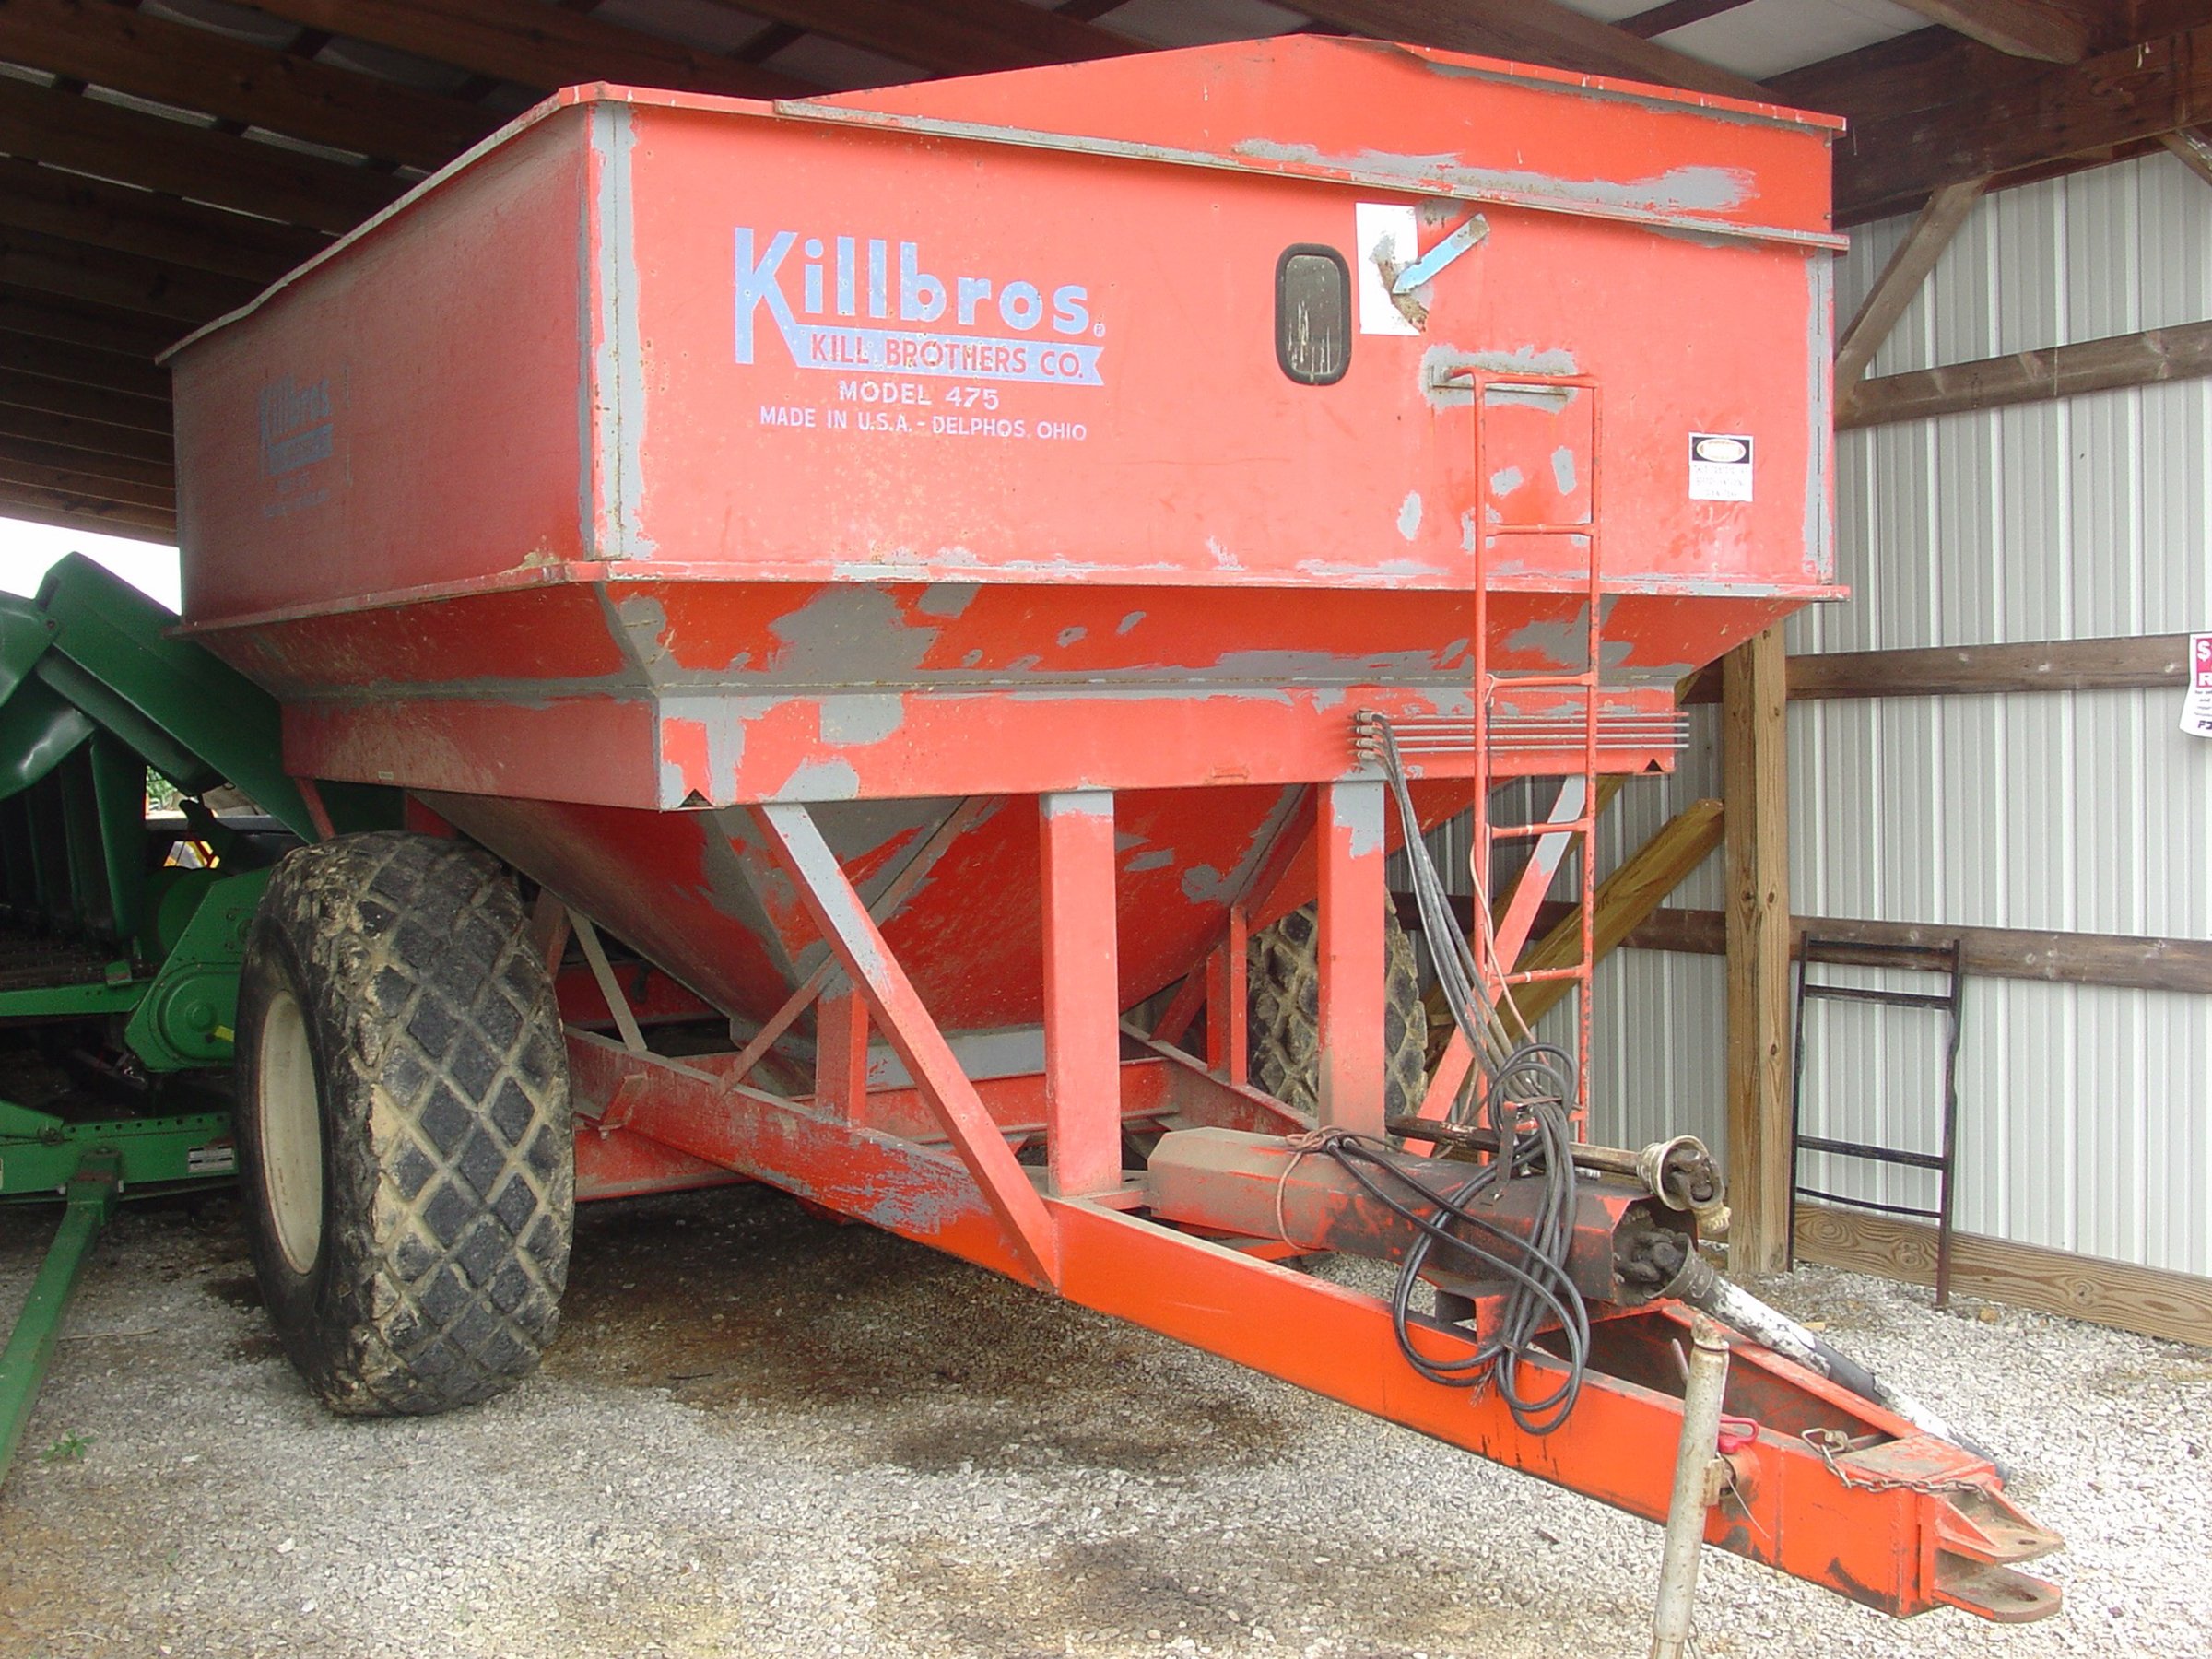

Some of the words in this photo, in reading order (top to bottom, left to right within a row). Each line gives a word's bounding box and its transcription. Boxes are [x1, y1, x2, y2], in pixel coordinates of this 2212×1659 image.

[735, 227, 1090, 365] Killbros
[810, 333, 870, 364] KILL
[885, 338, 1027, 374] BROTHERS
[1040, 350, 1084, 379] CO.
[839, 380, 933, 406] MODEL
[945, 386, 1000, 411] 475
[759, 406, 817, 428] MADE
[827, 409, 847, 429] IN
[1037, 421, 1087, 441] OHIO
